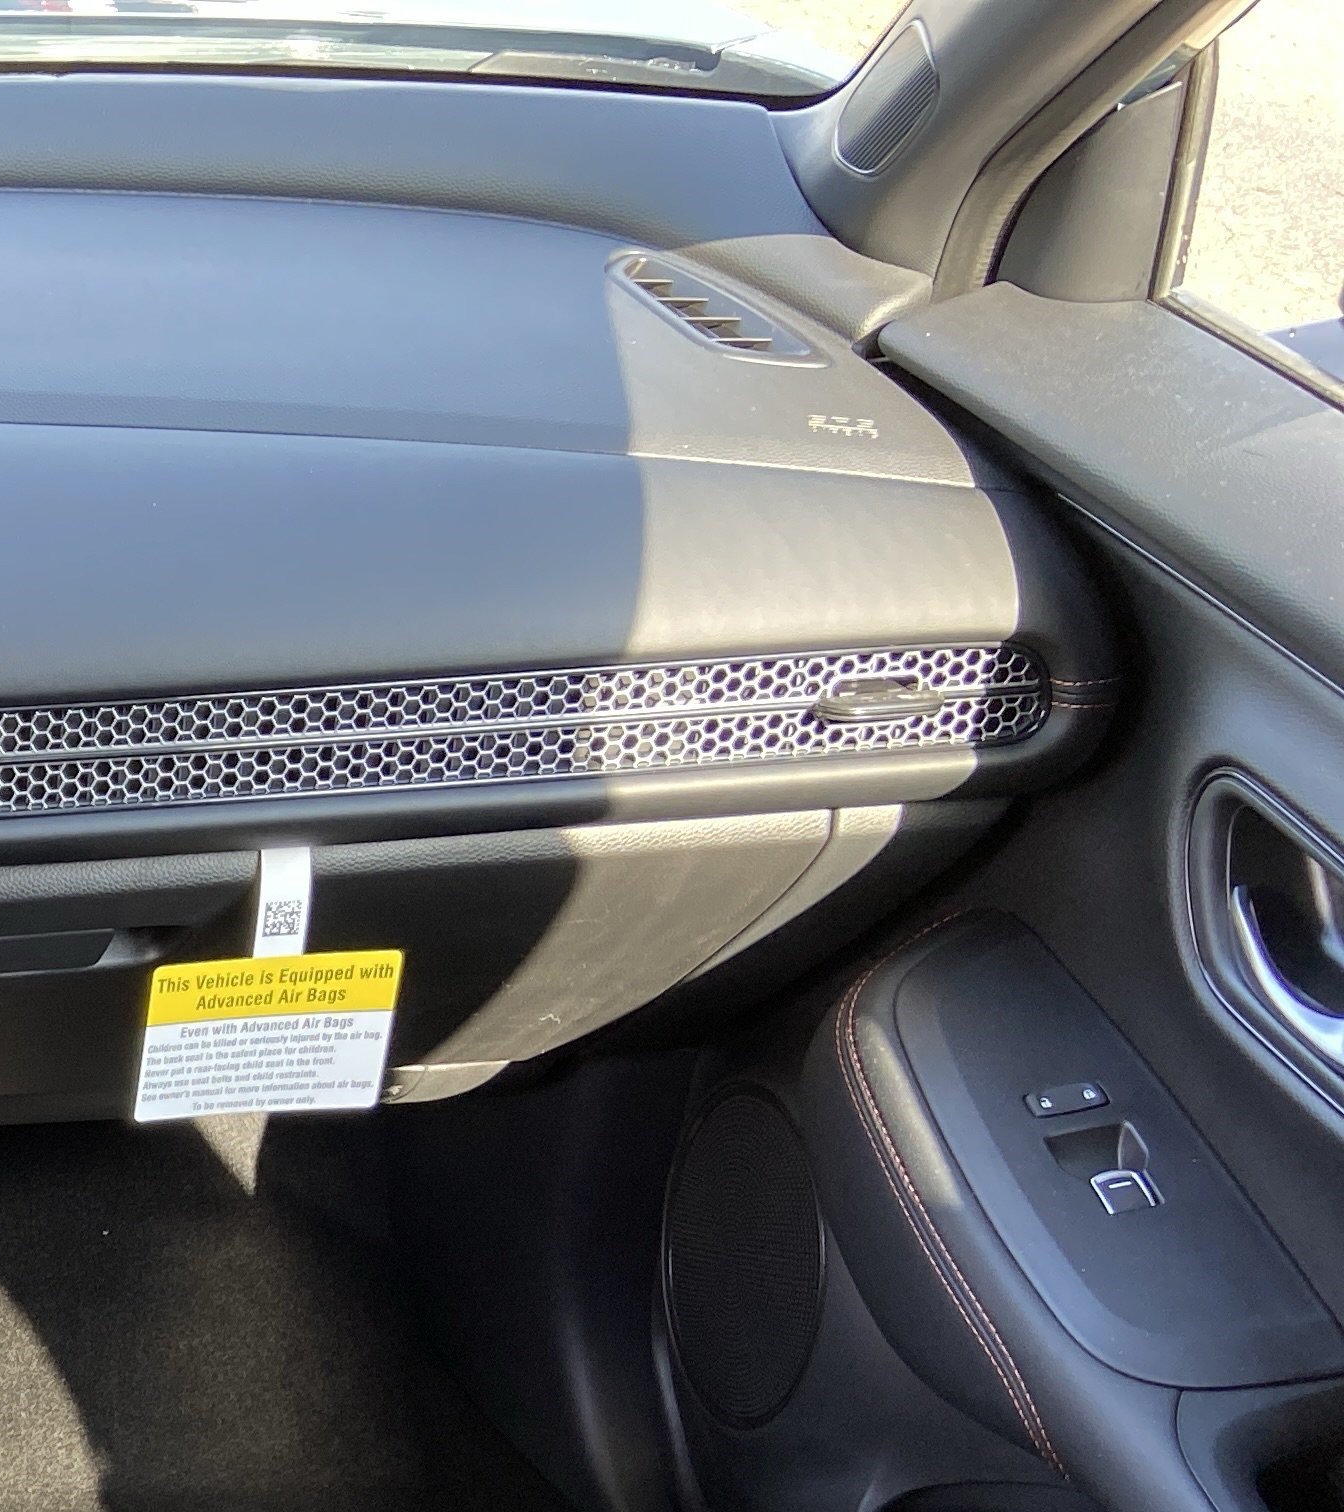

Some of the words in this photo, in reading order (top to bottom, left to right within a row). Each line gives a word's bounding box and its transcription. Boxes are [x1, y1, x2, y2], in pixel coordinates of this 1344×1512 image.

[158, 977, 190, 993] This
[196, 971, 254, 990] Vehicle
[278, 964, 354, 986] Equipped
[359, 963, 394, 979] with
[196, 989, 273, 1010] Advanced
[278, 988, 303, 1004] Air
[306, 988, 347, 1004] Bags
[180, 1026, 209, 1039] Even
[212, 1022, 237, 1036] with
[240, 1018, 299, 1033] Advanced
[302, 1017, 321, 1029] Air
[324, 1016, 354, 1030] Bags
[148, 1043, 182, 1054] Children
[184, 1042, 199, 1050] can
[201, 1040, 211, 1049] be
[213, 1038, 237, 1047] killed
[250, 1034, 288, 1045] seriously
[290, 1033, 321, 1044] injured
[322, 1032, 333, 1042] by
[334, 1031, 348, 1040] the
[350, 1030, 362, 1040] air
[364, 1030, 382, 1041] bag.
[146, 1056, 161, 1066] The
[163, 1055, 183, 1065] back
[215, 1050, 229, 1060] the
[231, 1048, 257, 1058] safest
[258, 1046, 282, 1058] place
[284, 1045, 297, 1055] for
[298, 1043, 336, 1055] children.
[144, 1068, 169, 1078] Never
[170, 1066, 185, 1077] put
[242, 1060, 263, 1070] child
[265, 1058, 284, 1068] seat
[296, 1056, 311, 1066] the
[312, 1056, 335, 1066] front.
[141, 1092, 157, 1102] See
[192, 1086, 223, 1097] manual
[224, 1085, 237, 1095] for
[238, 1085, 260, 1093] more
[261, 1081, 310, 1092] information
[312, 1080, 335, 1090] about
[337, 1080, 349, 1089] air
[142, 1079, 172, 1091] Always
[234, 1072, 251, 1082] and
[252, 1070, 274, 1081] child
[275, 1069, 319, 1080] restraints.
[192, 1101, 202, 1110] To
[204, 1100, 214, 1110] be
[216, 1098, 254, 1109] removed
[255, 1096, 266, 1108] by
[267, 1096, 293, 1105] owner
